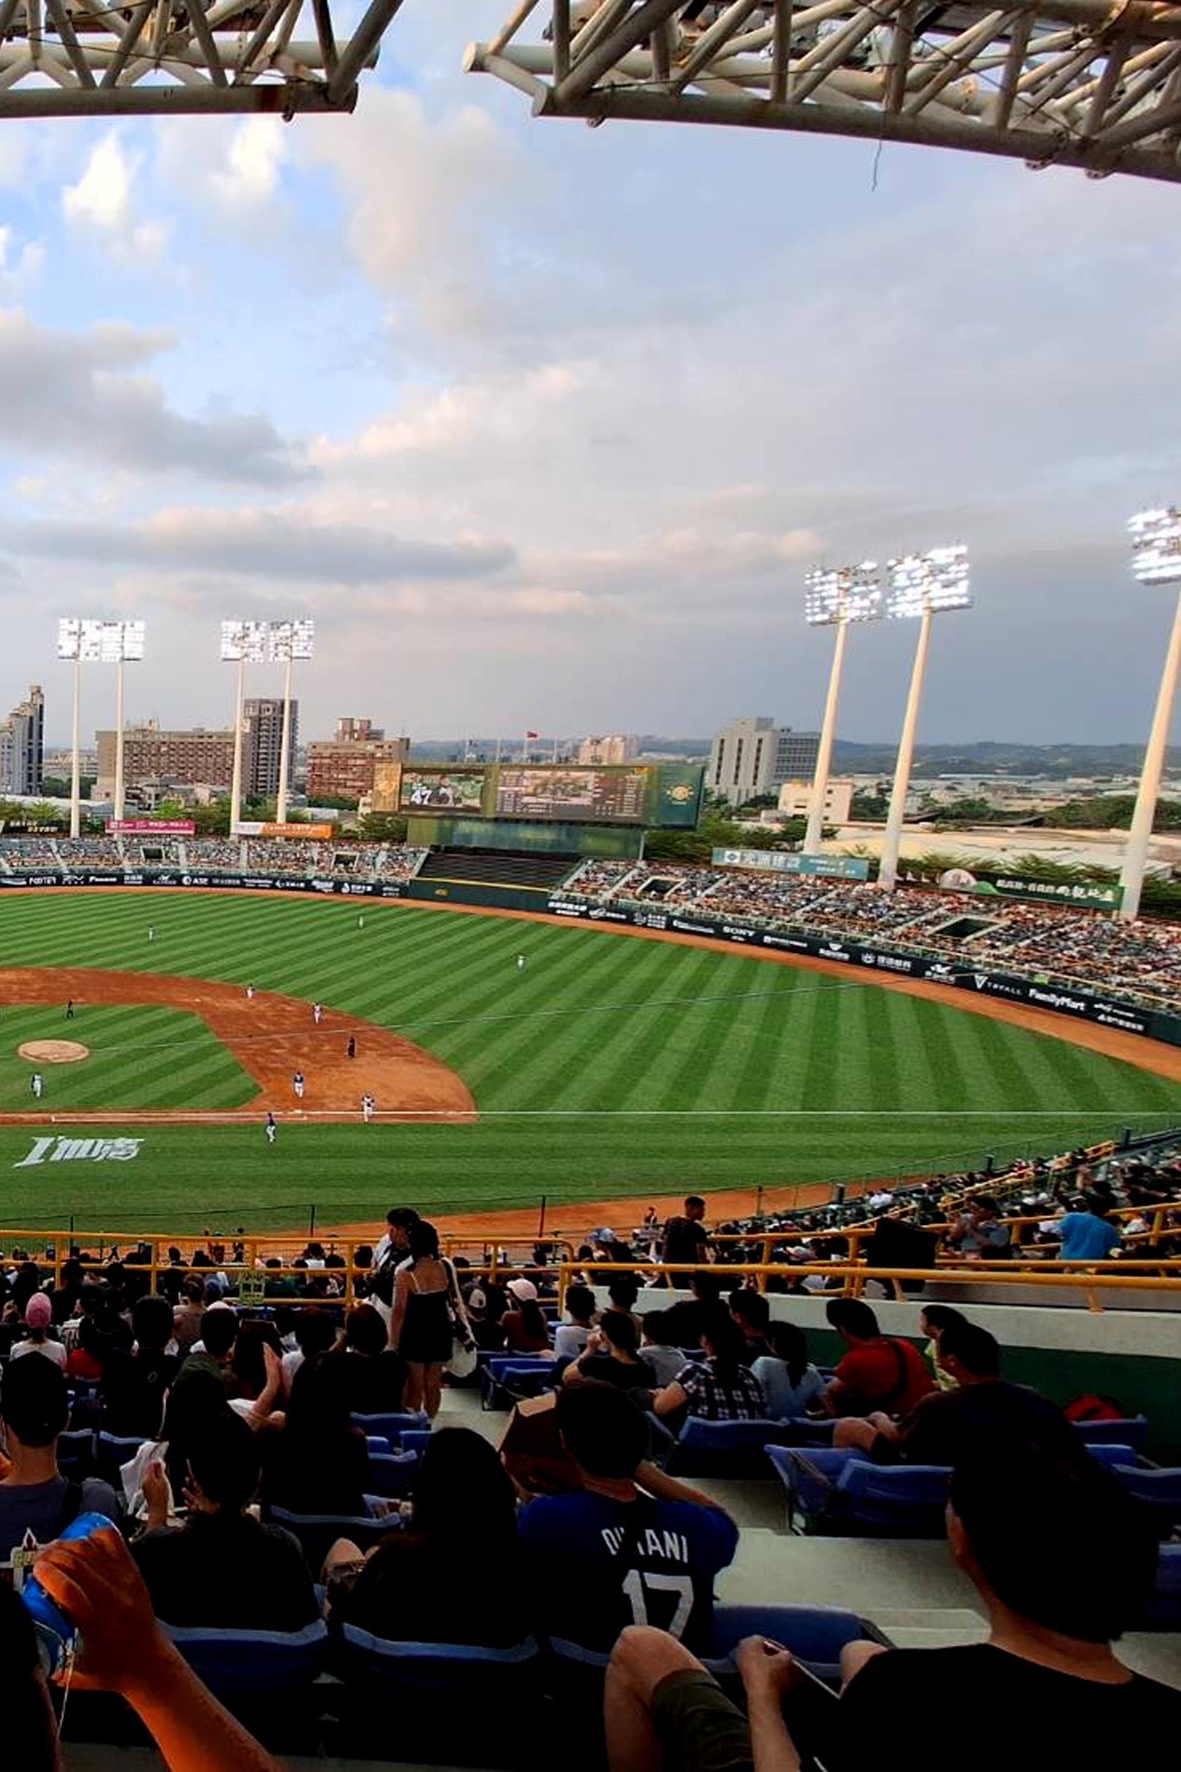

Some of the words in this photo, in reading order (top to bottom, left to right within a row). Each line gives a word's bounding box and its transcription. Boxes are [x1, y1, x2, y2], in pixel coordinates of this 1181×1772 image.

[723, 925, 755, 937] SONY
[1029, 988, 1086, 1012] FamilyMart
[601, 1526, 689, 1564] OANI
[622, 1569, 695, 1640] 17
